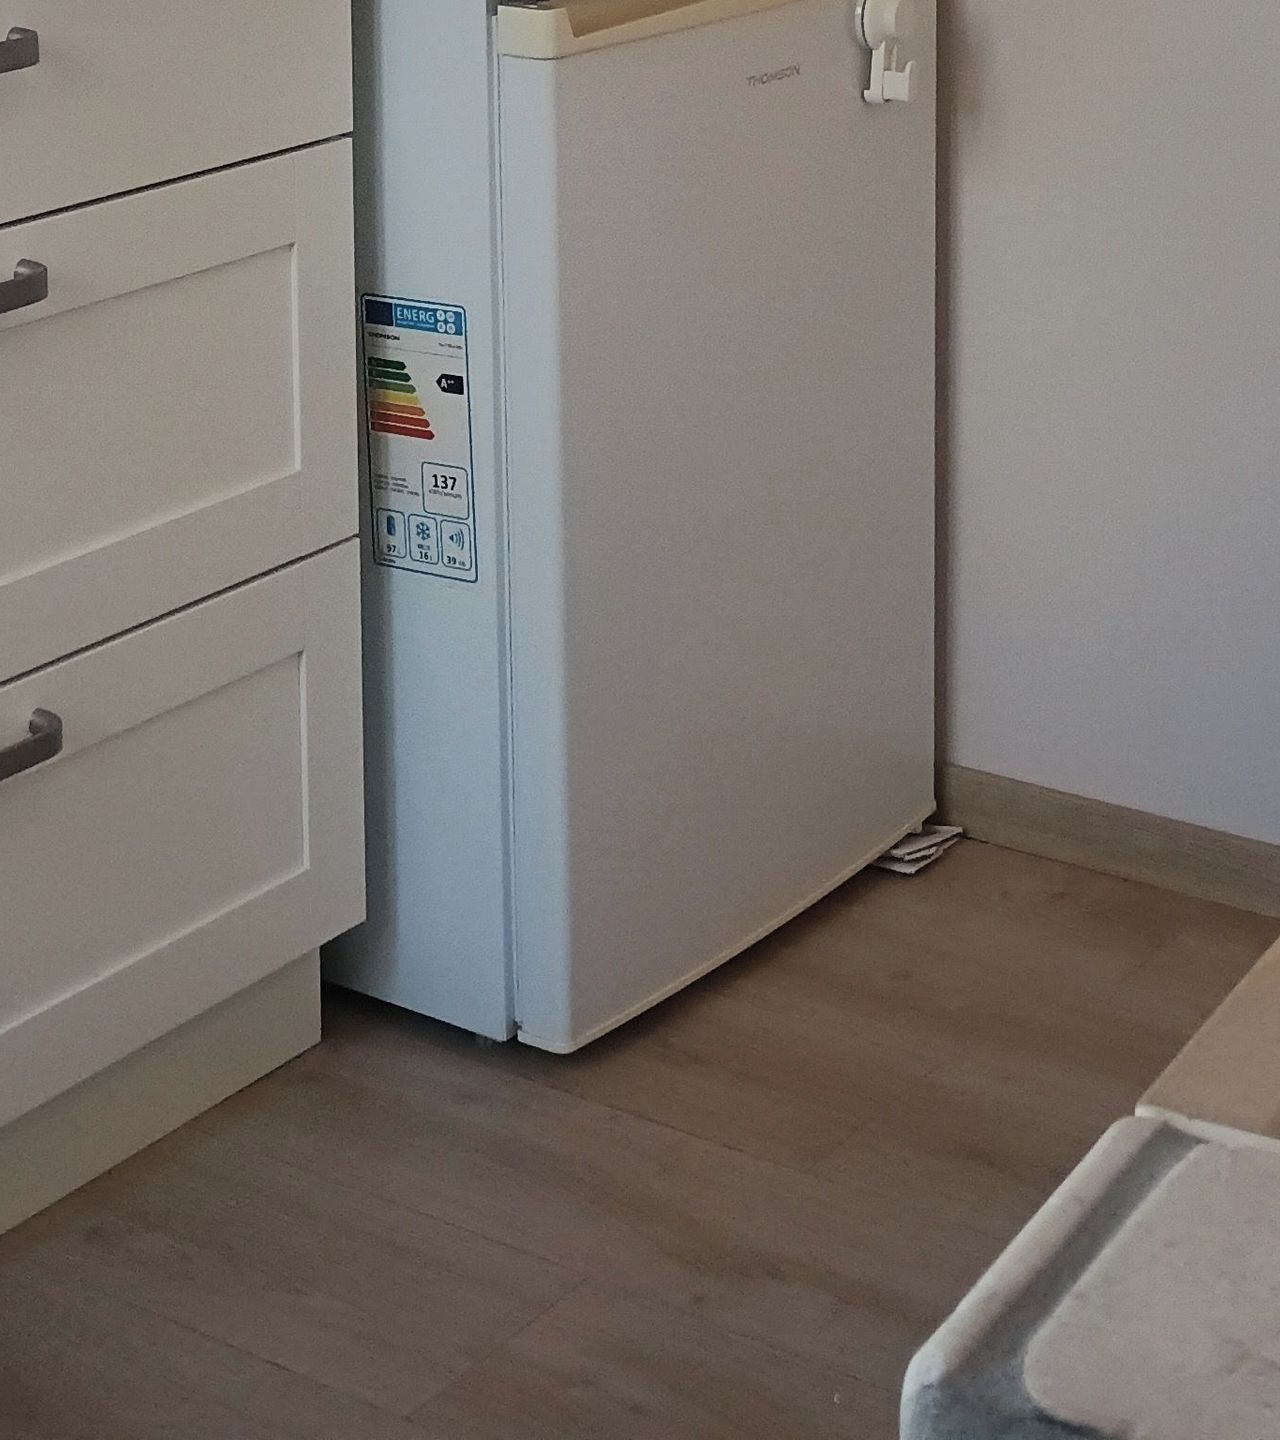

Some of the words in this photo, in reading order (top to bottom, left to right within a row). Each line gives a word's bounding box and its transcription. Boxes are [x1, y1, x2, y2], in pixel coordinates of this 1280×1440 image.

[745, 63, 801, 87] THOMSON
[396, 307, 435, 322] ENERG
[432, 474, 457, 490] 137
[419, 550, 429, 560] 16
[446, 555, 457, 565] 39
